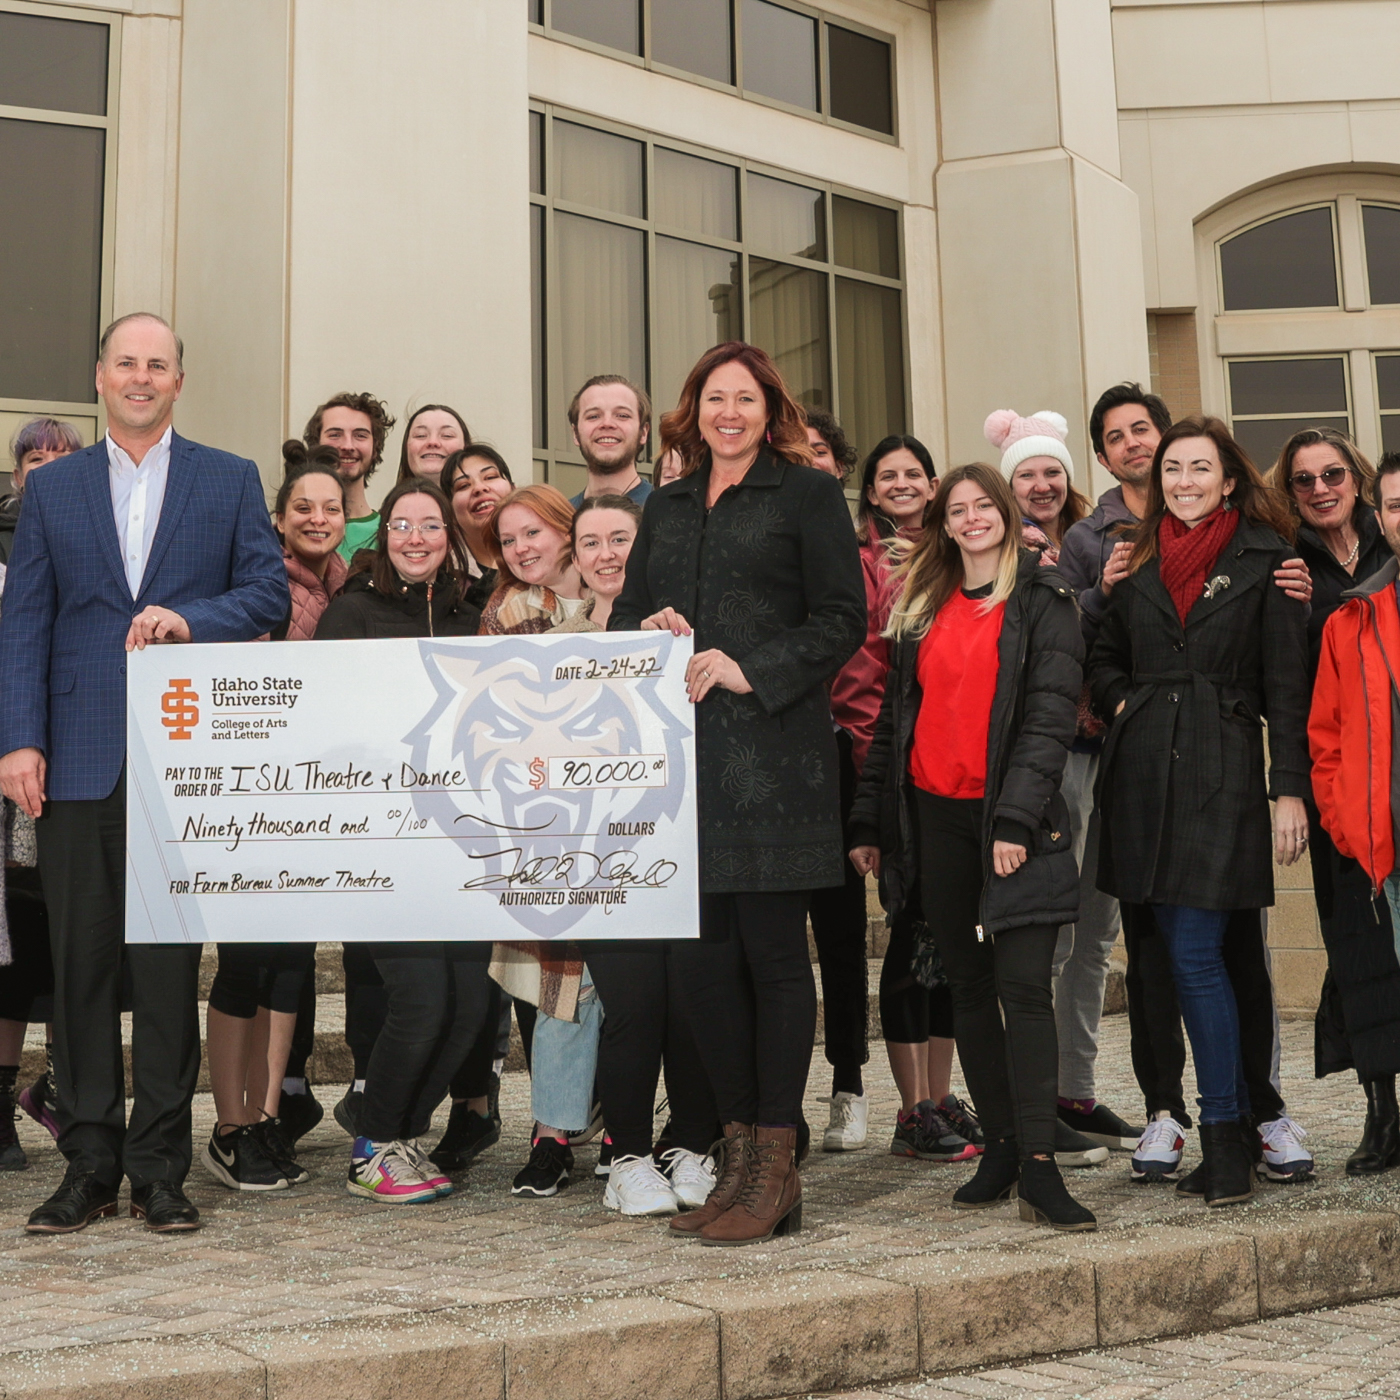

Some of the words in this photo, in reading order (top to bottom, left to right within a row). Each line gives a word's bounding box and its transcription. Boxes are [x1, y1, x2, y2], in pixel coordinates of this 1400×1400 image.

[556, 667, 582, 680] DATE
[585, 657, 662, 679] 2-24-22
[211, 678, 258, 692] Idaho
[262, 676, 303, 690] State
[212, 692, 298, 709] University
[211, 719, 250, 730] College
[253, 719, 264, 728] of
[266, 719, 288, 728] Arts
[211, 730, 232, 740] and
[234, 730, 270, 740] Letters
[165, 767, 186, 781] PAY
[188, 767, 201, 781] TO
[204, 766, 224, 780] THE
[295, 760, 374, 790] Theatre
[401, 760, 466, 788] Dance
[174, 784, 208, 797] ORDER
[210, 783, 224, 796] OF
[182, 812, 244, 852] Ninety
[247, 812, 332, 837] thousand
[340, 816, 370, 835] and
[608, 821, 656, 836] DOLLARS
[169, 881, 189, 894] FOR
[193, 872, 228, 893] Farm
[231, 873, 273, 892] Bureau
[278, 870, 330, 890] Summer
[335, 870, 394, 889] Theatre
[499, 891, 565, 906] AUTHORIZED
[567, 890, 628, 905] SIGNATURE
